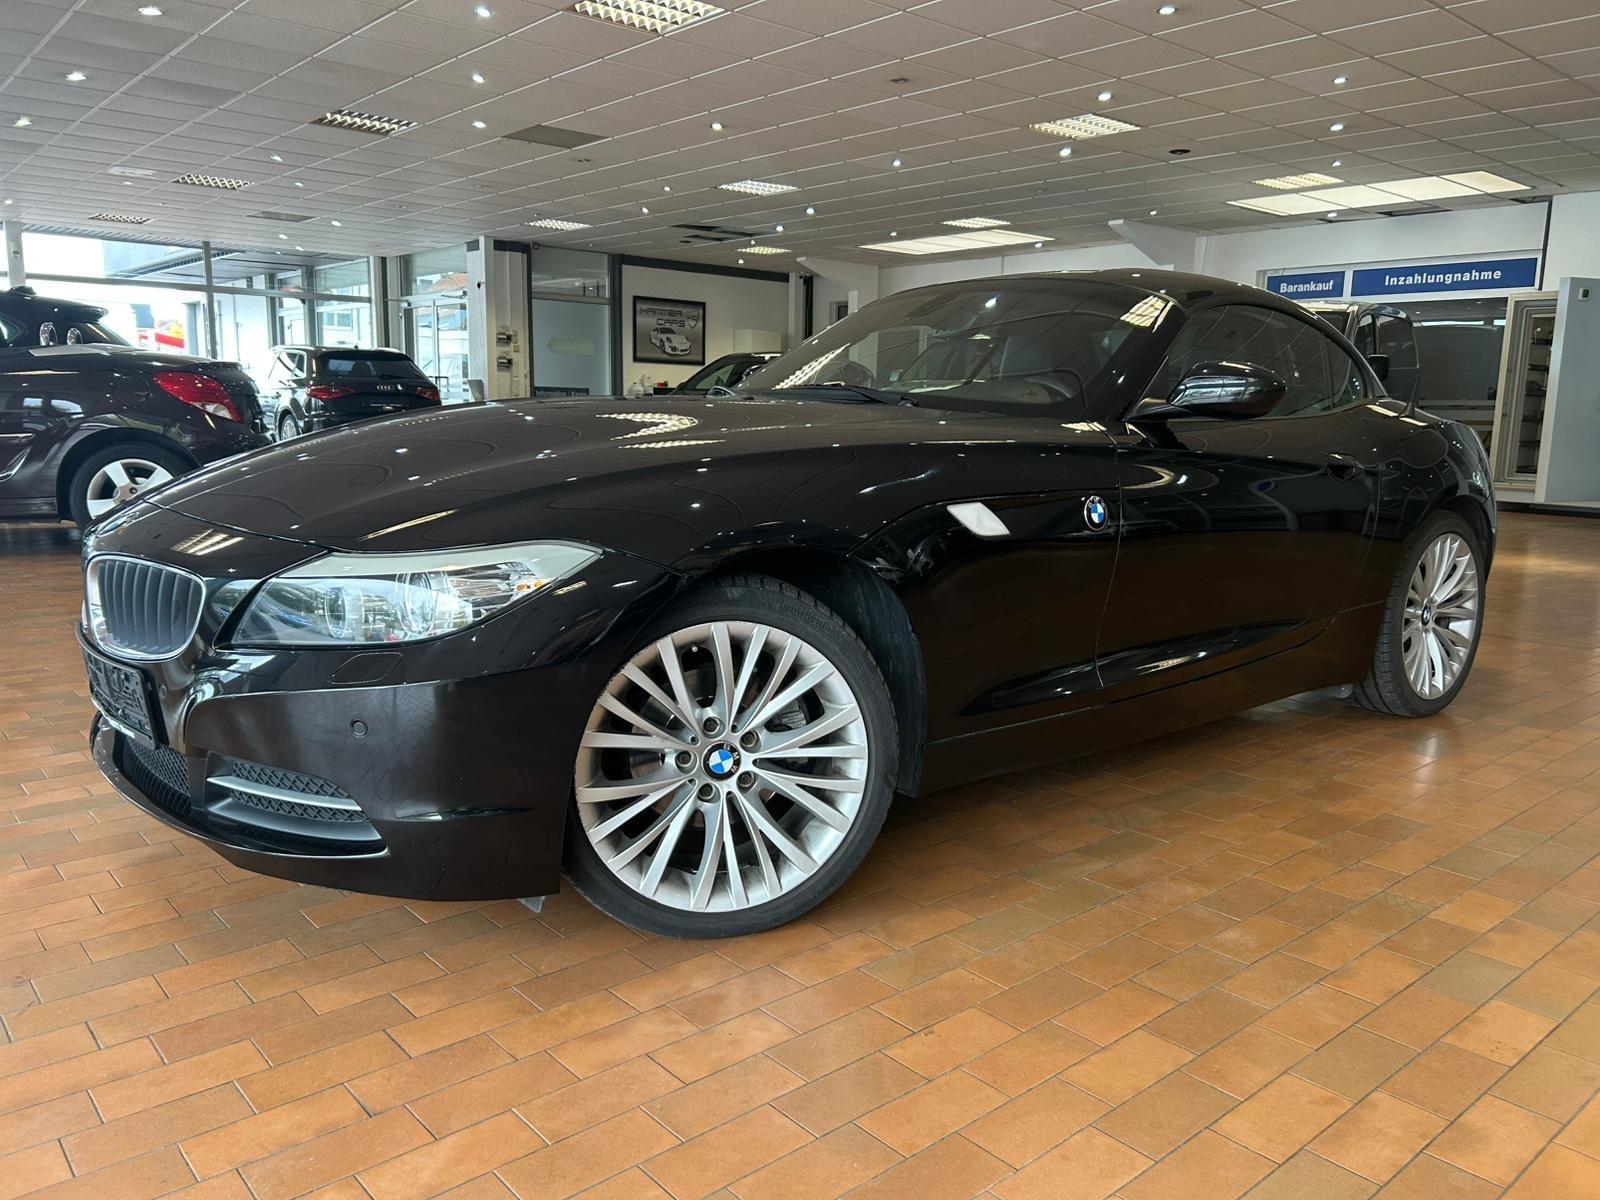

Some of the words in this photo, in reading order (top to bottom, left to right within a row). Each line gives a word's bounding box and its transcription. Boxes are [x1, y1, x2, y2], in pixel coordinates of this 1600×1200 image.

[1384, 268, 1502, 286] Inzahlungnahme
[1279, 279, 1334, 294] Barankauf
[640, 307, 683, 316] HAMMER
[656, 318, 686, 328] CARS
